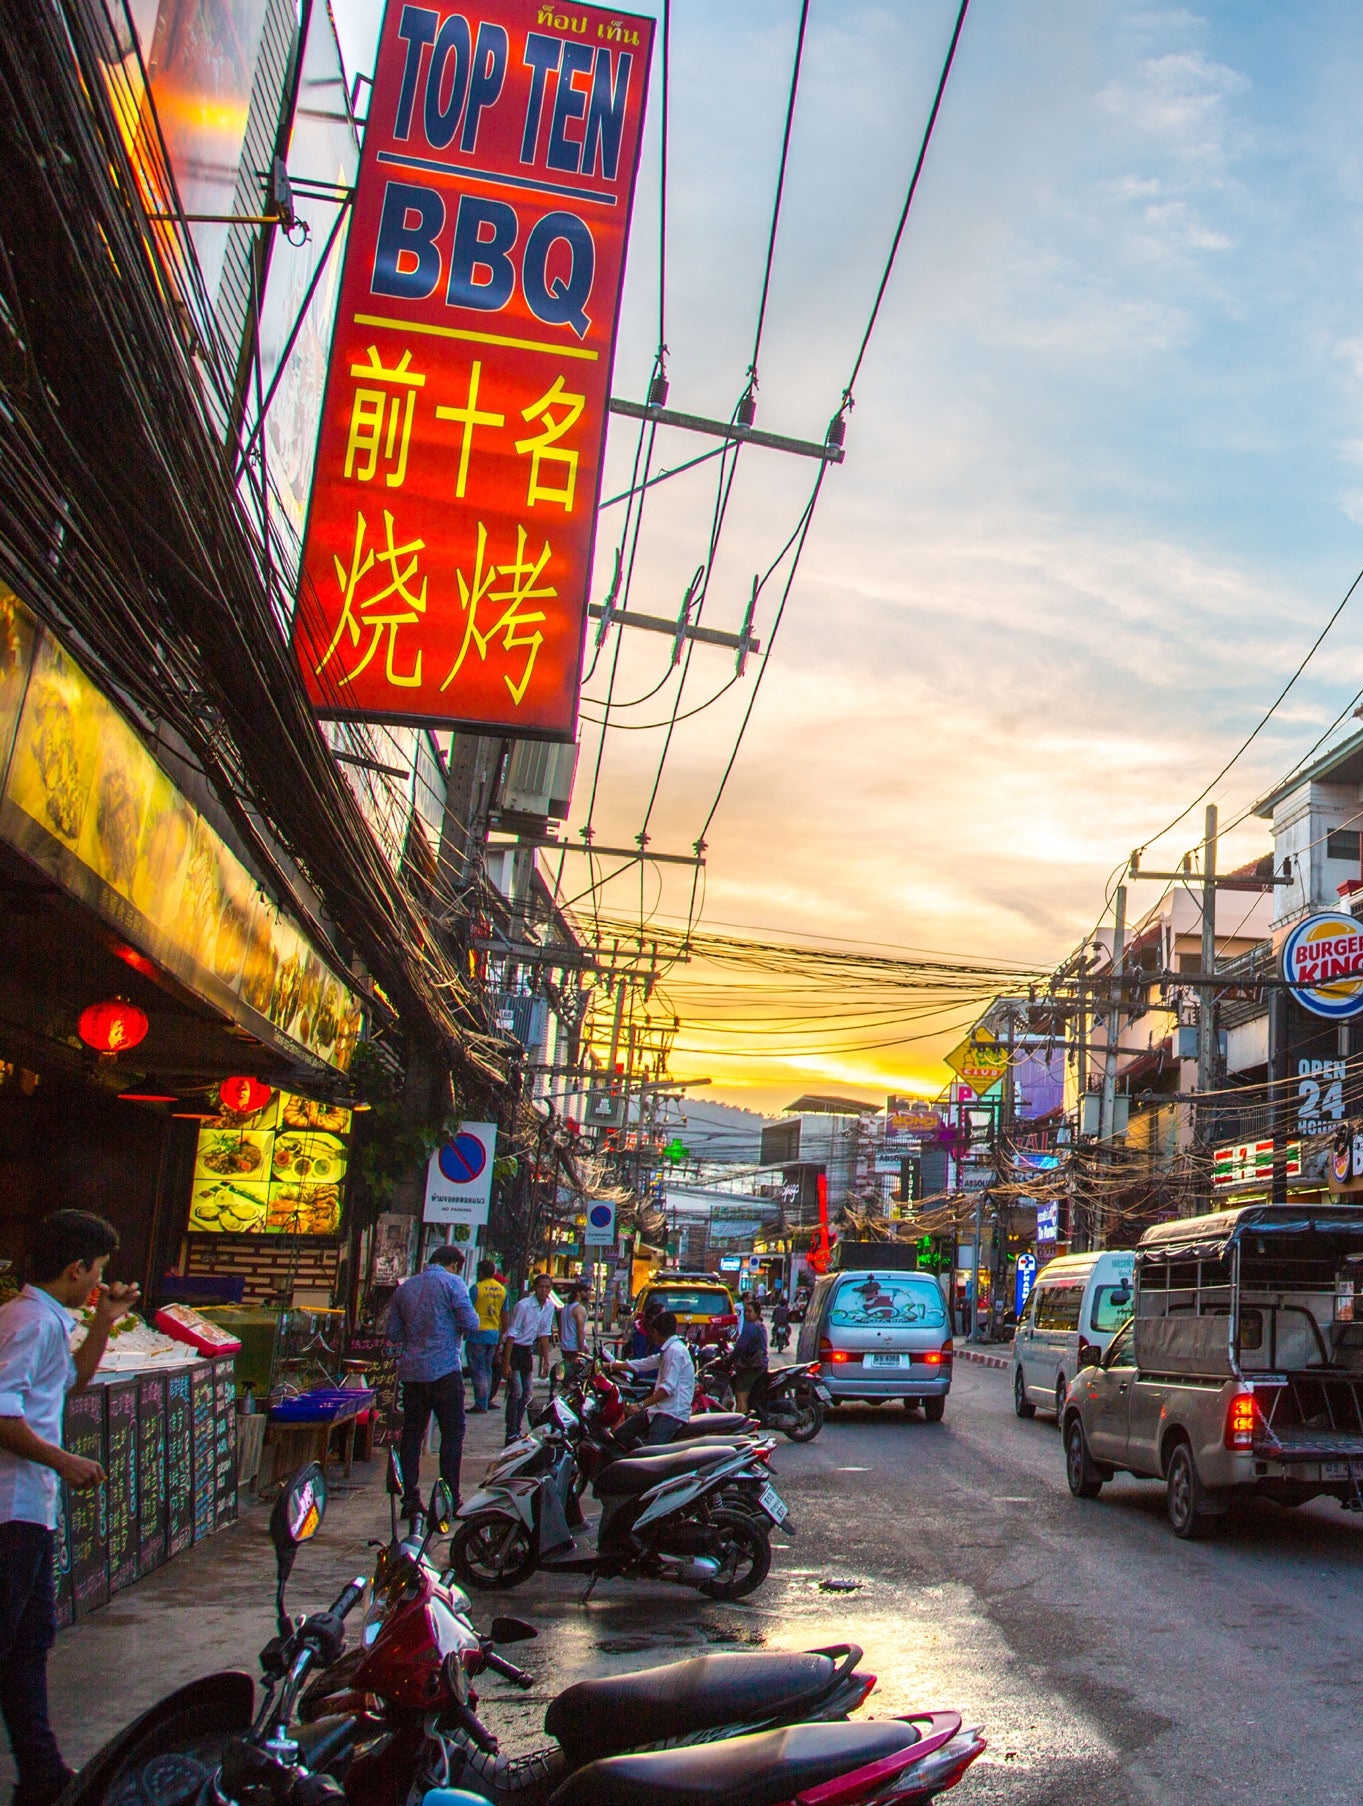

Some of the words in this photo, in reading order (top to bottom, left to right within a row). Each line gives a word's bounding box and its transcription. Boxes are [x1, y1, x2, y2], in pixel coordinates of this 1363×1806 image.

[393, 4, 510, 154] TOP
[520, 32, 633, 181] TEN
[537, 5, 588, 33] ท็อป
[597, 20, 640, 46] เท็น
[370, 181, 596, 340] BBQ
[344, 345, 586, 512] 前十名
[315, 509, 558, 706] 烧烤
[1297, 1080, 1346, 1119] 24
[1298, 1058, 1346, 1080] OPEN
